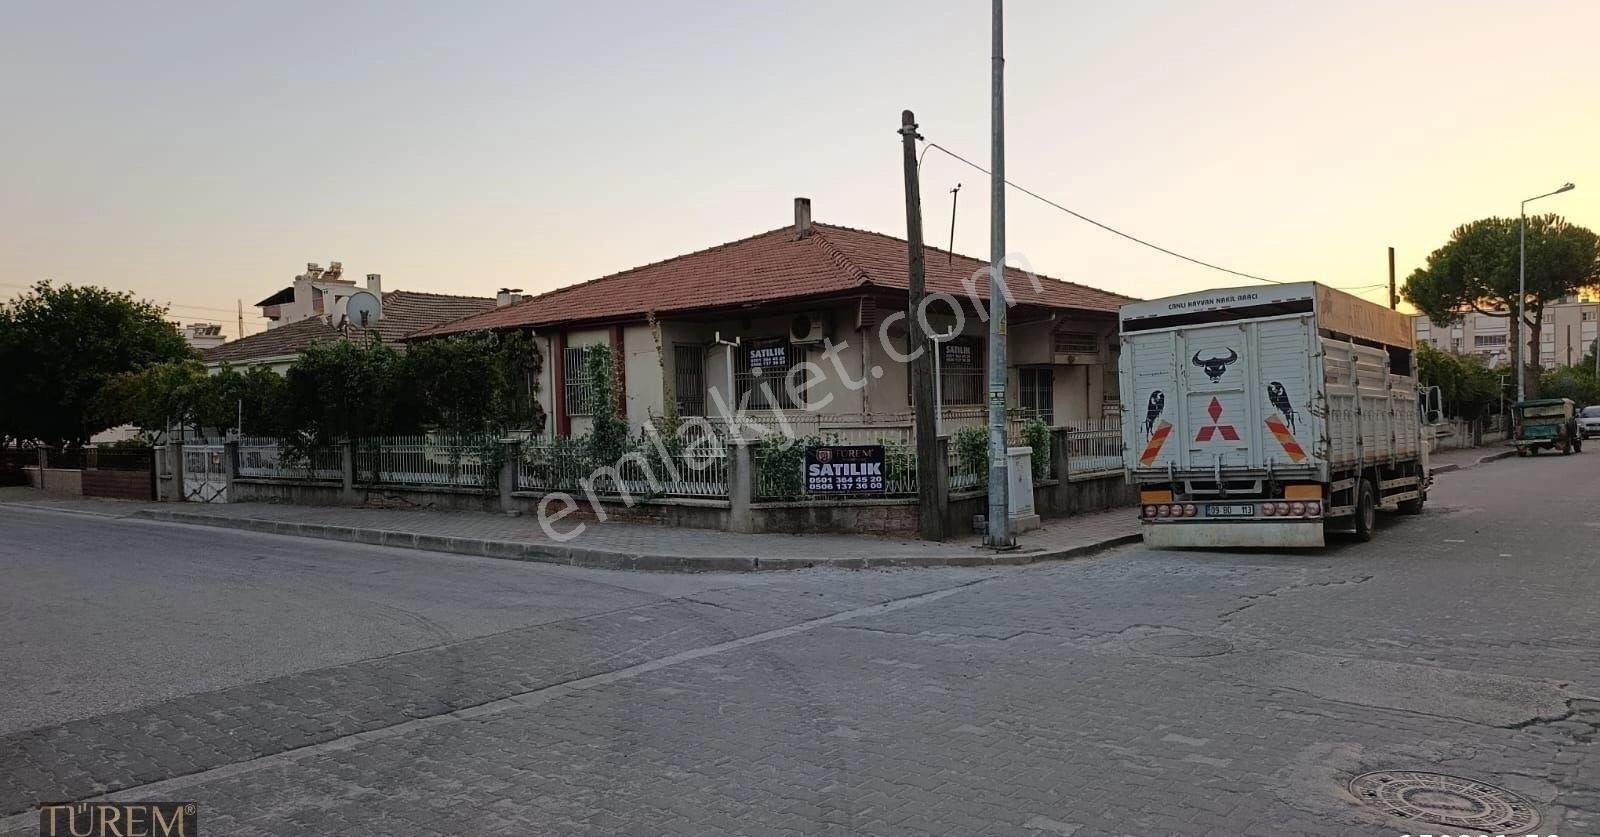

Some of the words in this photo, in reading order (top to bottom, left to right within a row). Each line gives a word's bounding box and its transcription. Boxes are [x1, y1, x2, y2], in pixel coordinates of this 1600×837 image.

[1187, 298, 1214, 307] HAYVAN
[750, 347, 785, 358] SATILIK
[809, 463, 881, 476] SATILIK
